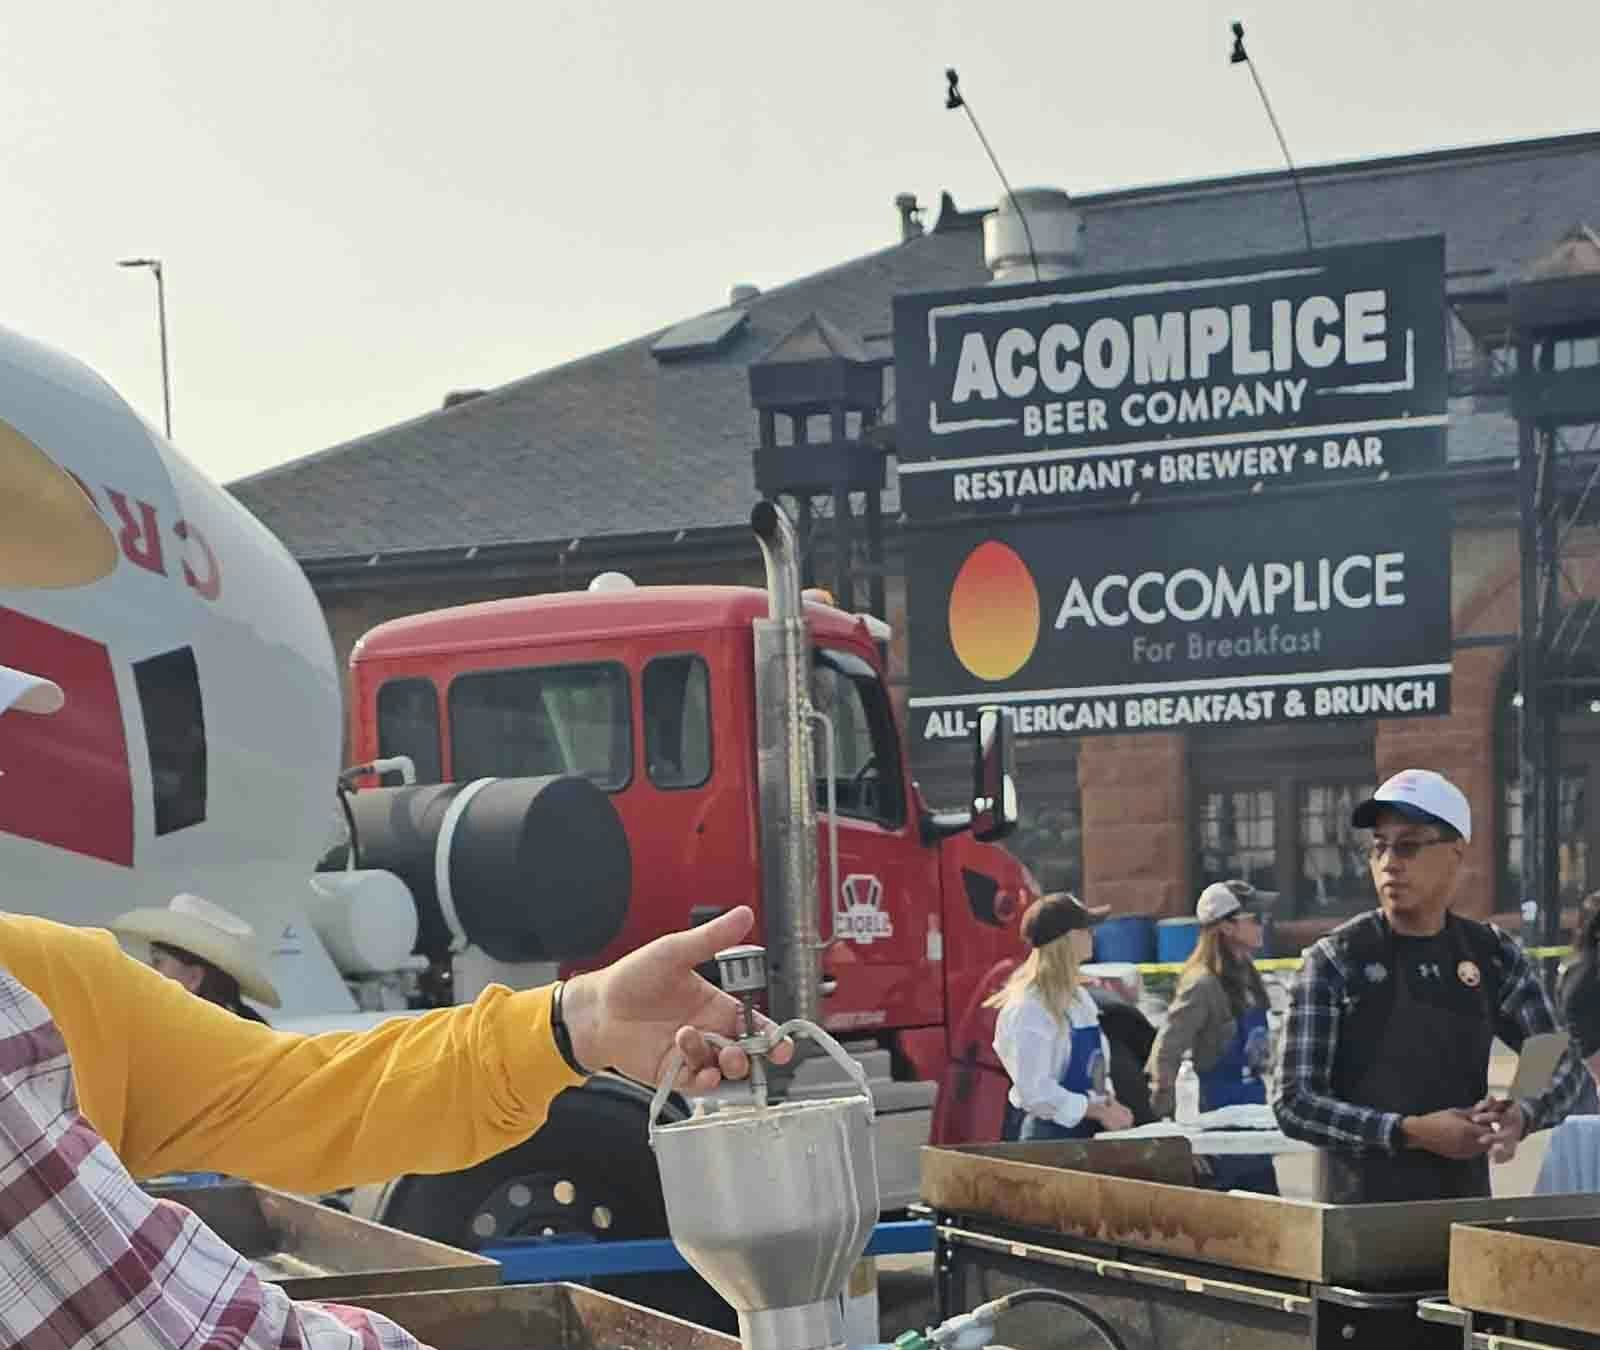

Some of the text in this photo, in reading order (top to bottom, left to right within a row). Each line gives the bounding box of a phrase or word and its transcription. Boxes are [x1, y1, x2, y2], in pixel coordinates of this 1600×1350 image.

[951, 289, 1388, 403] ACCOMPLICE
[1023, 378, 1308, 437] BEER COMPANY
[953, 436, 1384, 503] RESTAURANT BREWERY BAR
[1054, 552, 1406, 630] ACCOMPLICE
[1132, 624, 1322, 664] For Breakfast
[923, 681, 1436, 739] ALL-ERICAN BREAKFAST & BRUNCH
